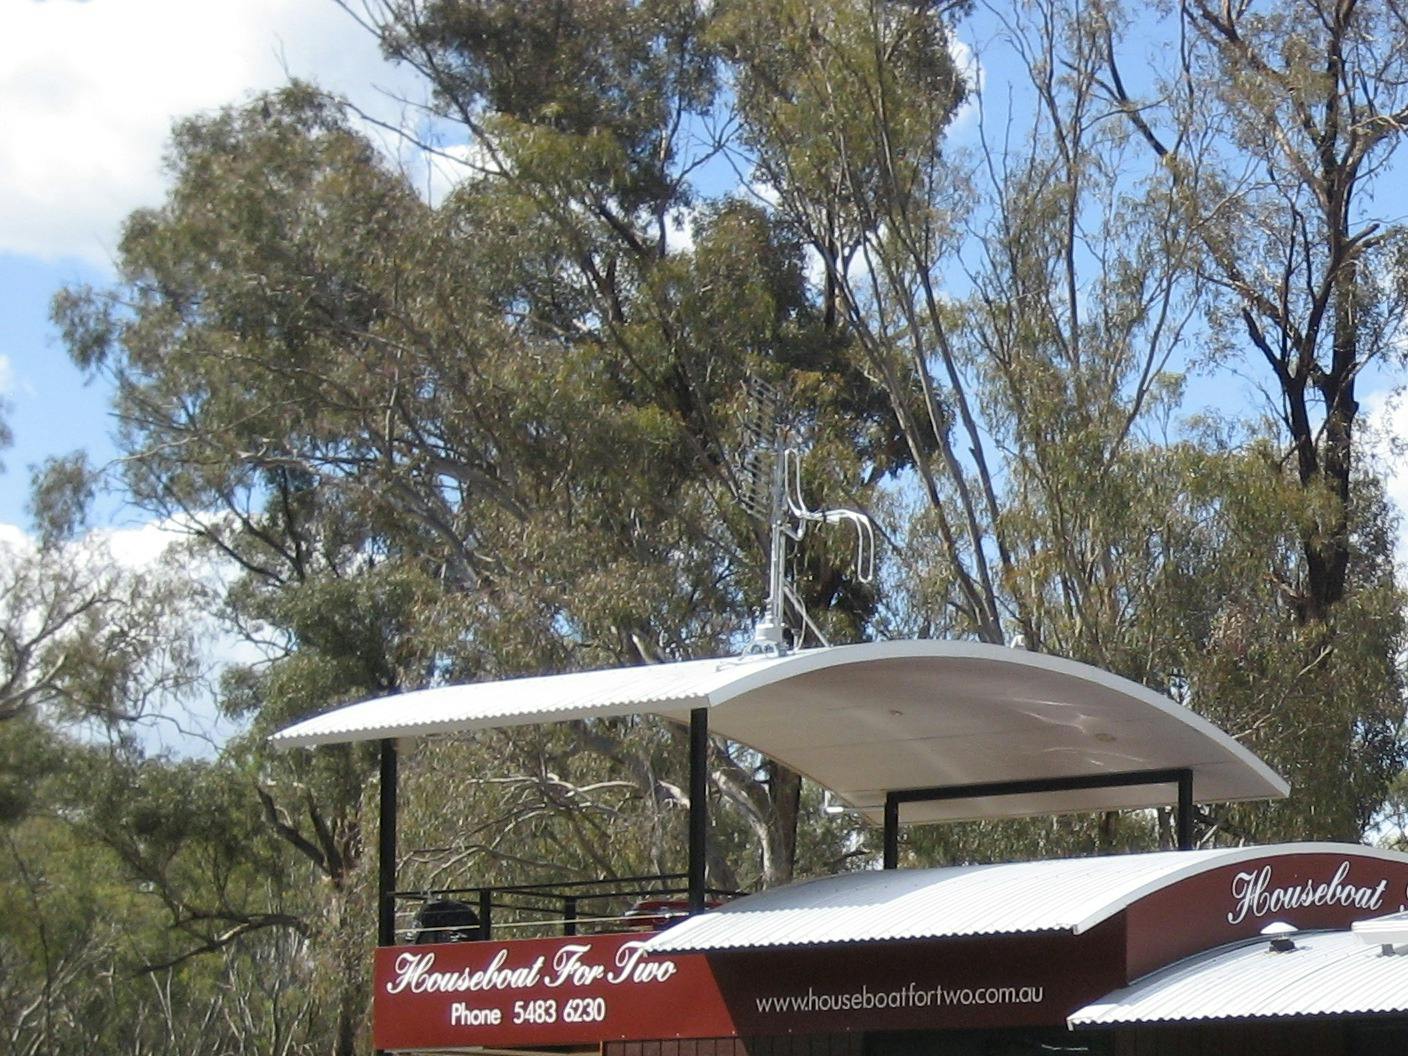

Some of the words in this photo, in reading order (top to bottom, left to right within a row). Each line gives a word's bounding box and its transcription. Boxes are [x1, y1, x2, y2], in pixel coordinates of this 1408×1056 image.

[1227, 860, 1388, 925] Houseboat
[386, 949, 547, 994] Houseboat
[544, 943, 605, 988] For
[607, 939, 678, 984] Two
[450, 1002, 503, 1026] Phone
[512, 1001, 558, 1024] 5483
[562, 997, 606, 1022] 6230
[755, 982, 1044, 1013] www.houseboatfortwo.com.au
